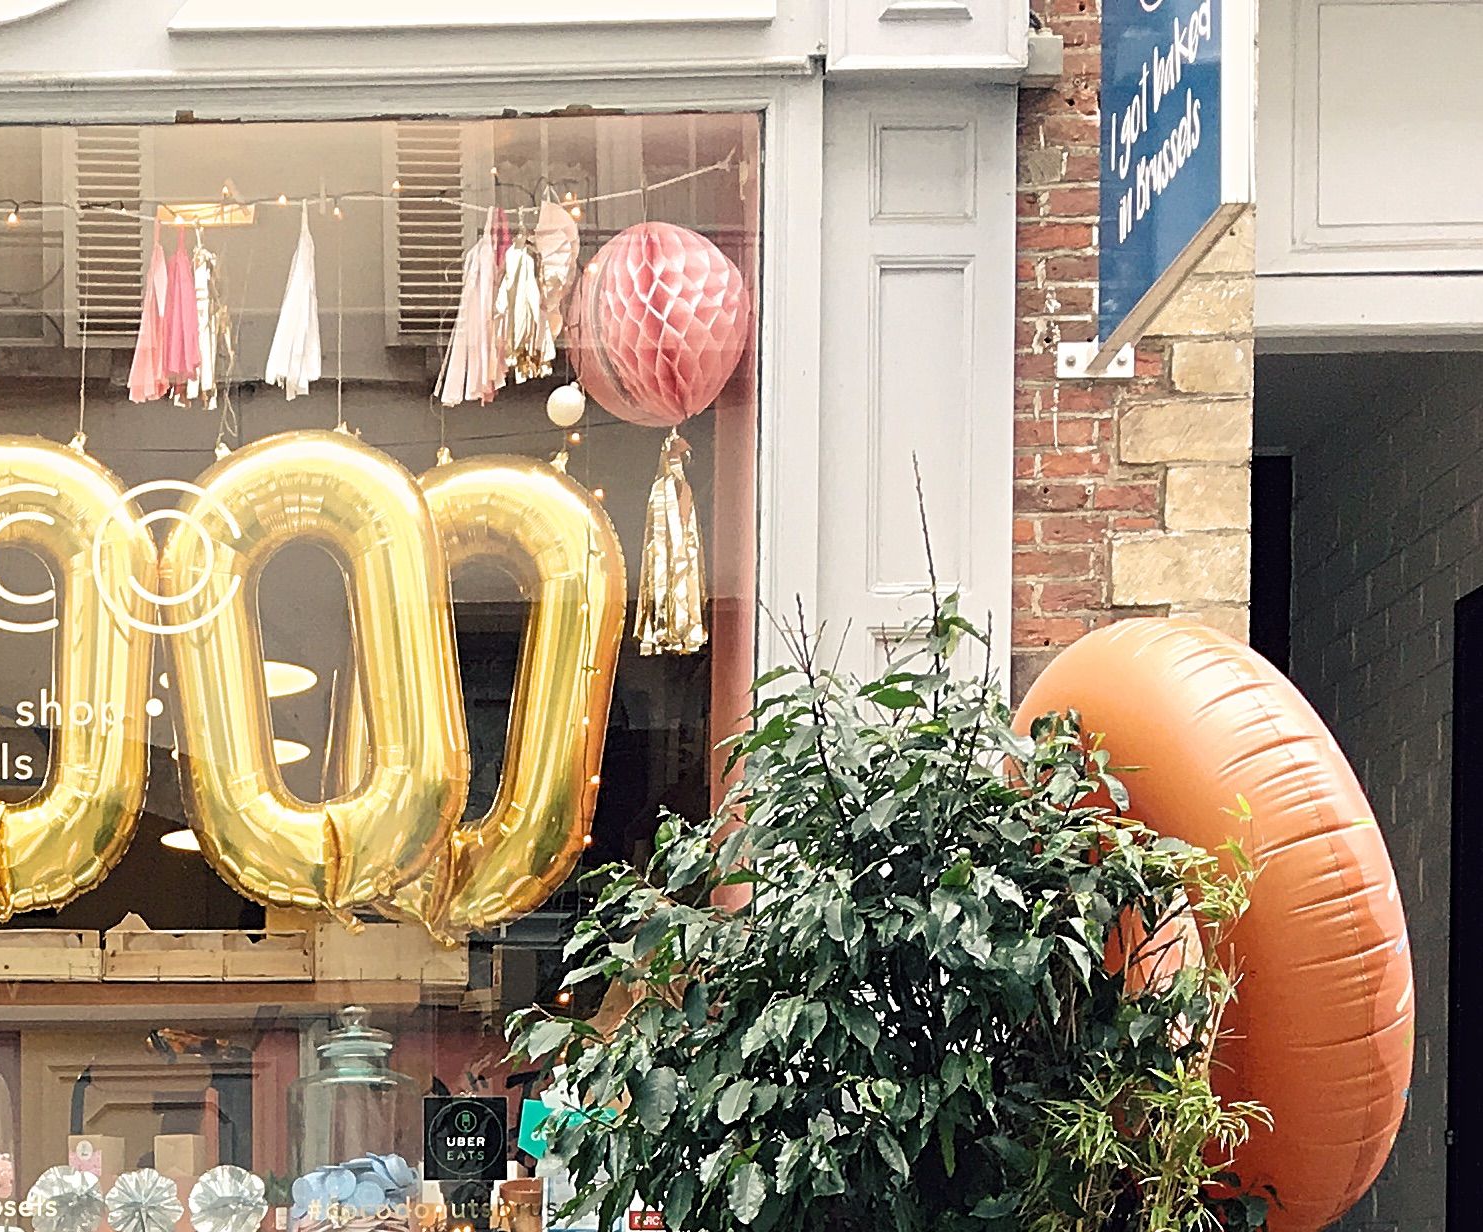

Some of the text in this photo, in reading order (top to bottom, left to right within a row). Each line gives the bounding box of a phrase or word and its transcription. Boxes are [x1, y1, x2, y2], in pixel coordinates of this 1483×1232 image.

[1119, 62, 1150, 180] got
[1153, 0, 1211, 113] baked
[1119, 87, 1201, 243] in Brussels
[17, 688, 124, 736] shop
[446, 1136, 485, 1147] UBER
[446, 1150, 485, 1161] EATS
